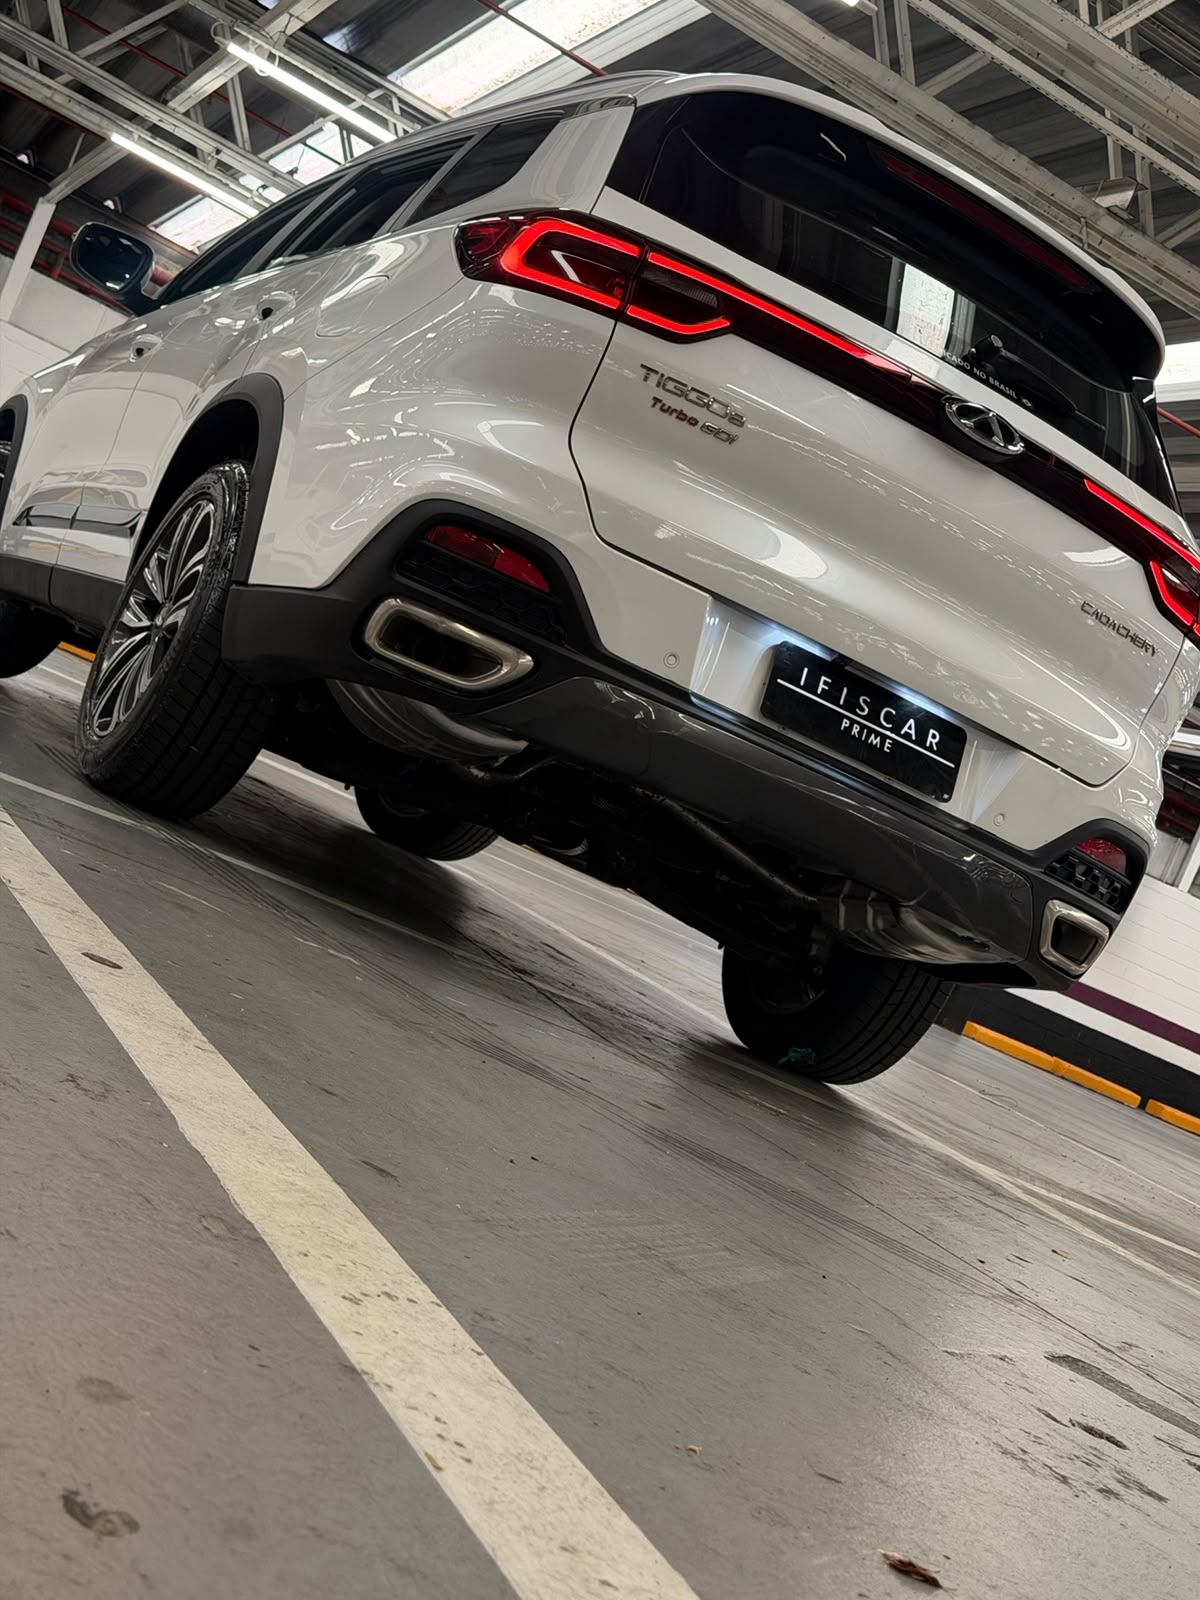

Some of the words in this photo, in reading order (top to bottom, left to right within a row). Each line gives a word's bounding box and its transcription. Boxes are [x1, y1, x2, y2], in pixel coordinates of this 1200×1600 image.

[973, 367, 987, 380] NO
[988, 376, 1018, 399] BRASIL
[651, 396, 700, 428] Turbo
[840, 718, 894, 753] PRIME
